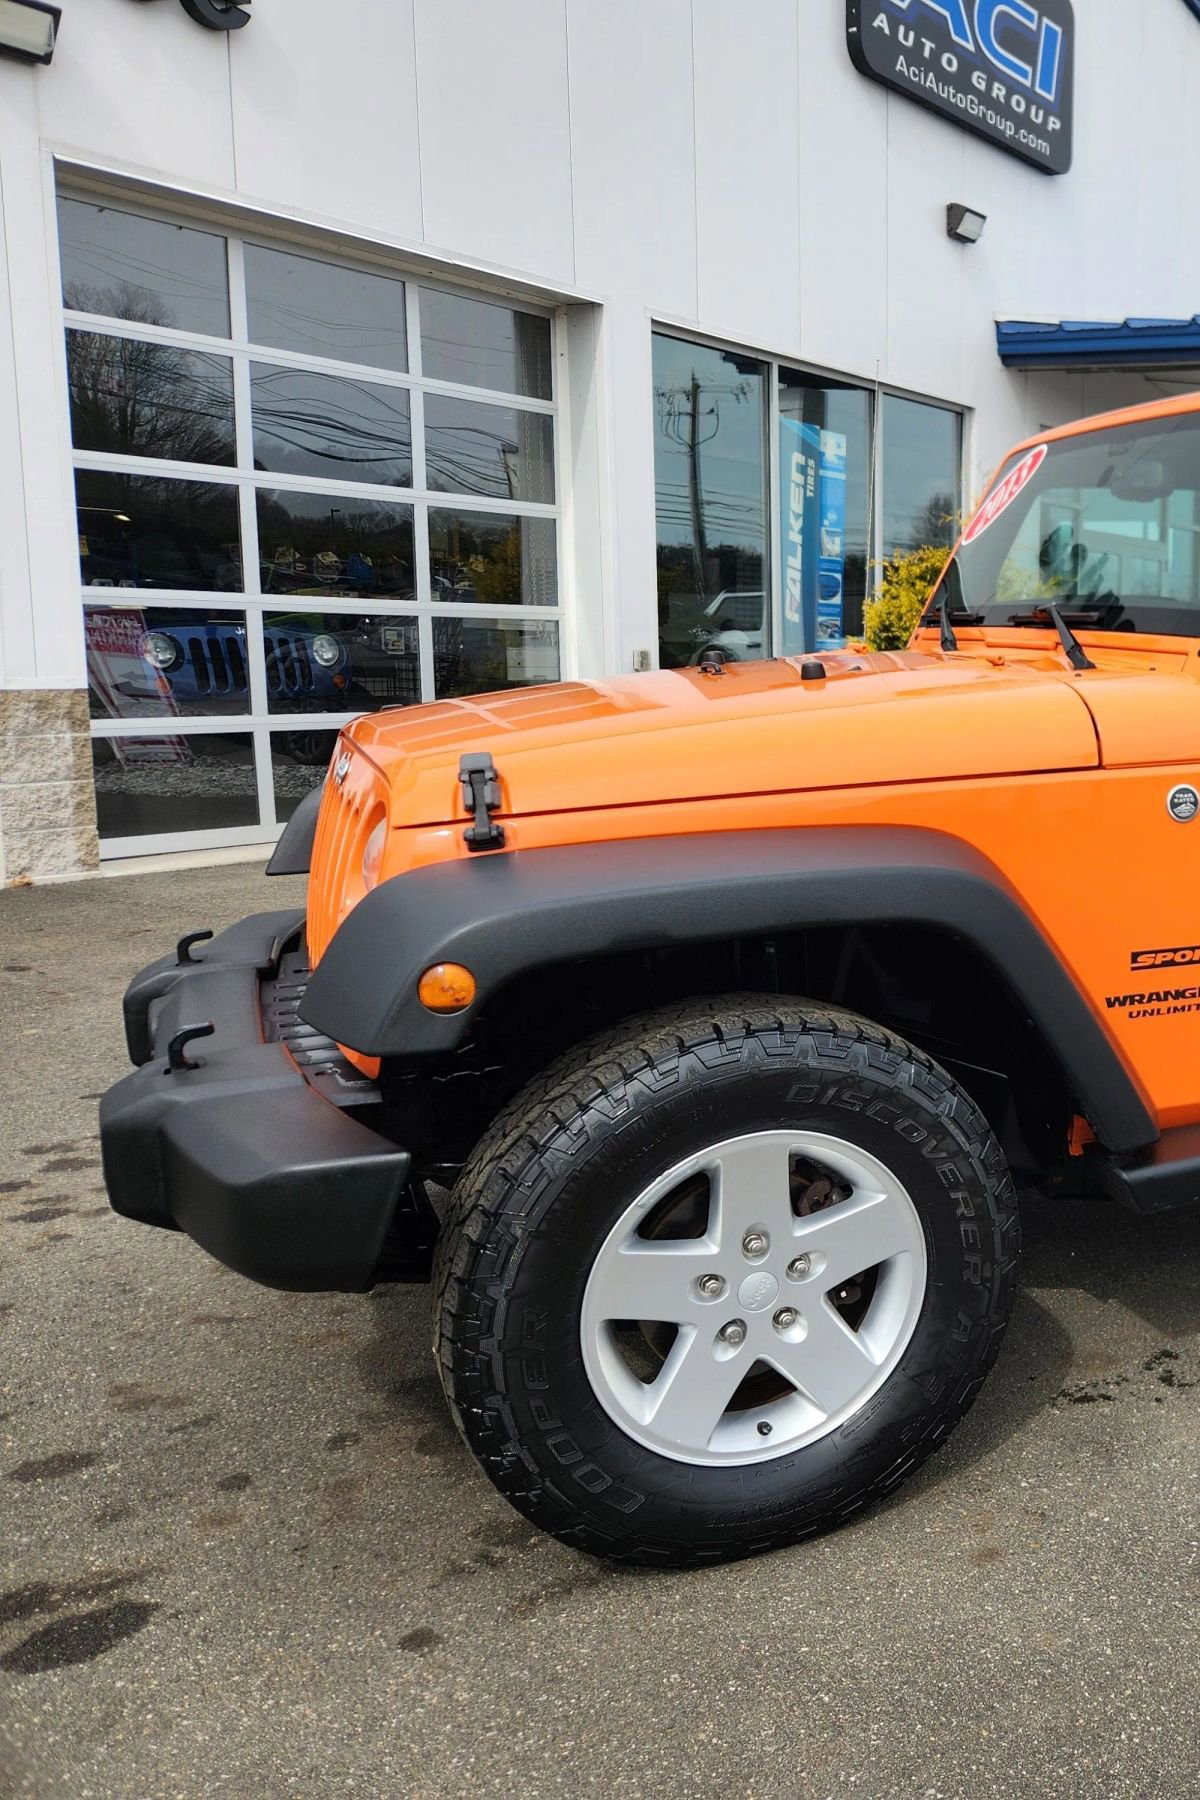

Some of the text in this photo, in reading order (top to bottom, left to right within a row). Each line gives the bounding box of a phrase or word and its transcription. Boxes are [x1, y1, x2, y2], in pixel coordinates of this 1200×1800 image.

[872, 12, 1062, 132] AUTO GROUP
[896, 55, 1050, 156] AciAutoGroup.com
[785, 451, 806, 623] FALKEN
[806, 458, 816, 498] TIRES
[785, 1081, 984, 1285] DISCOVERER
[519, 1309, 647, 1514] COOPER
